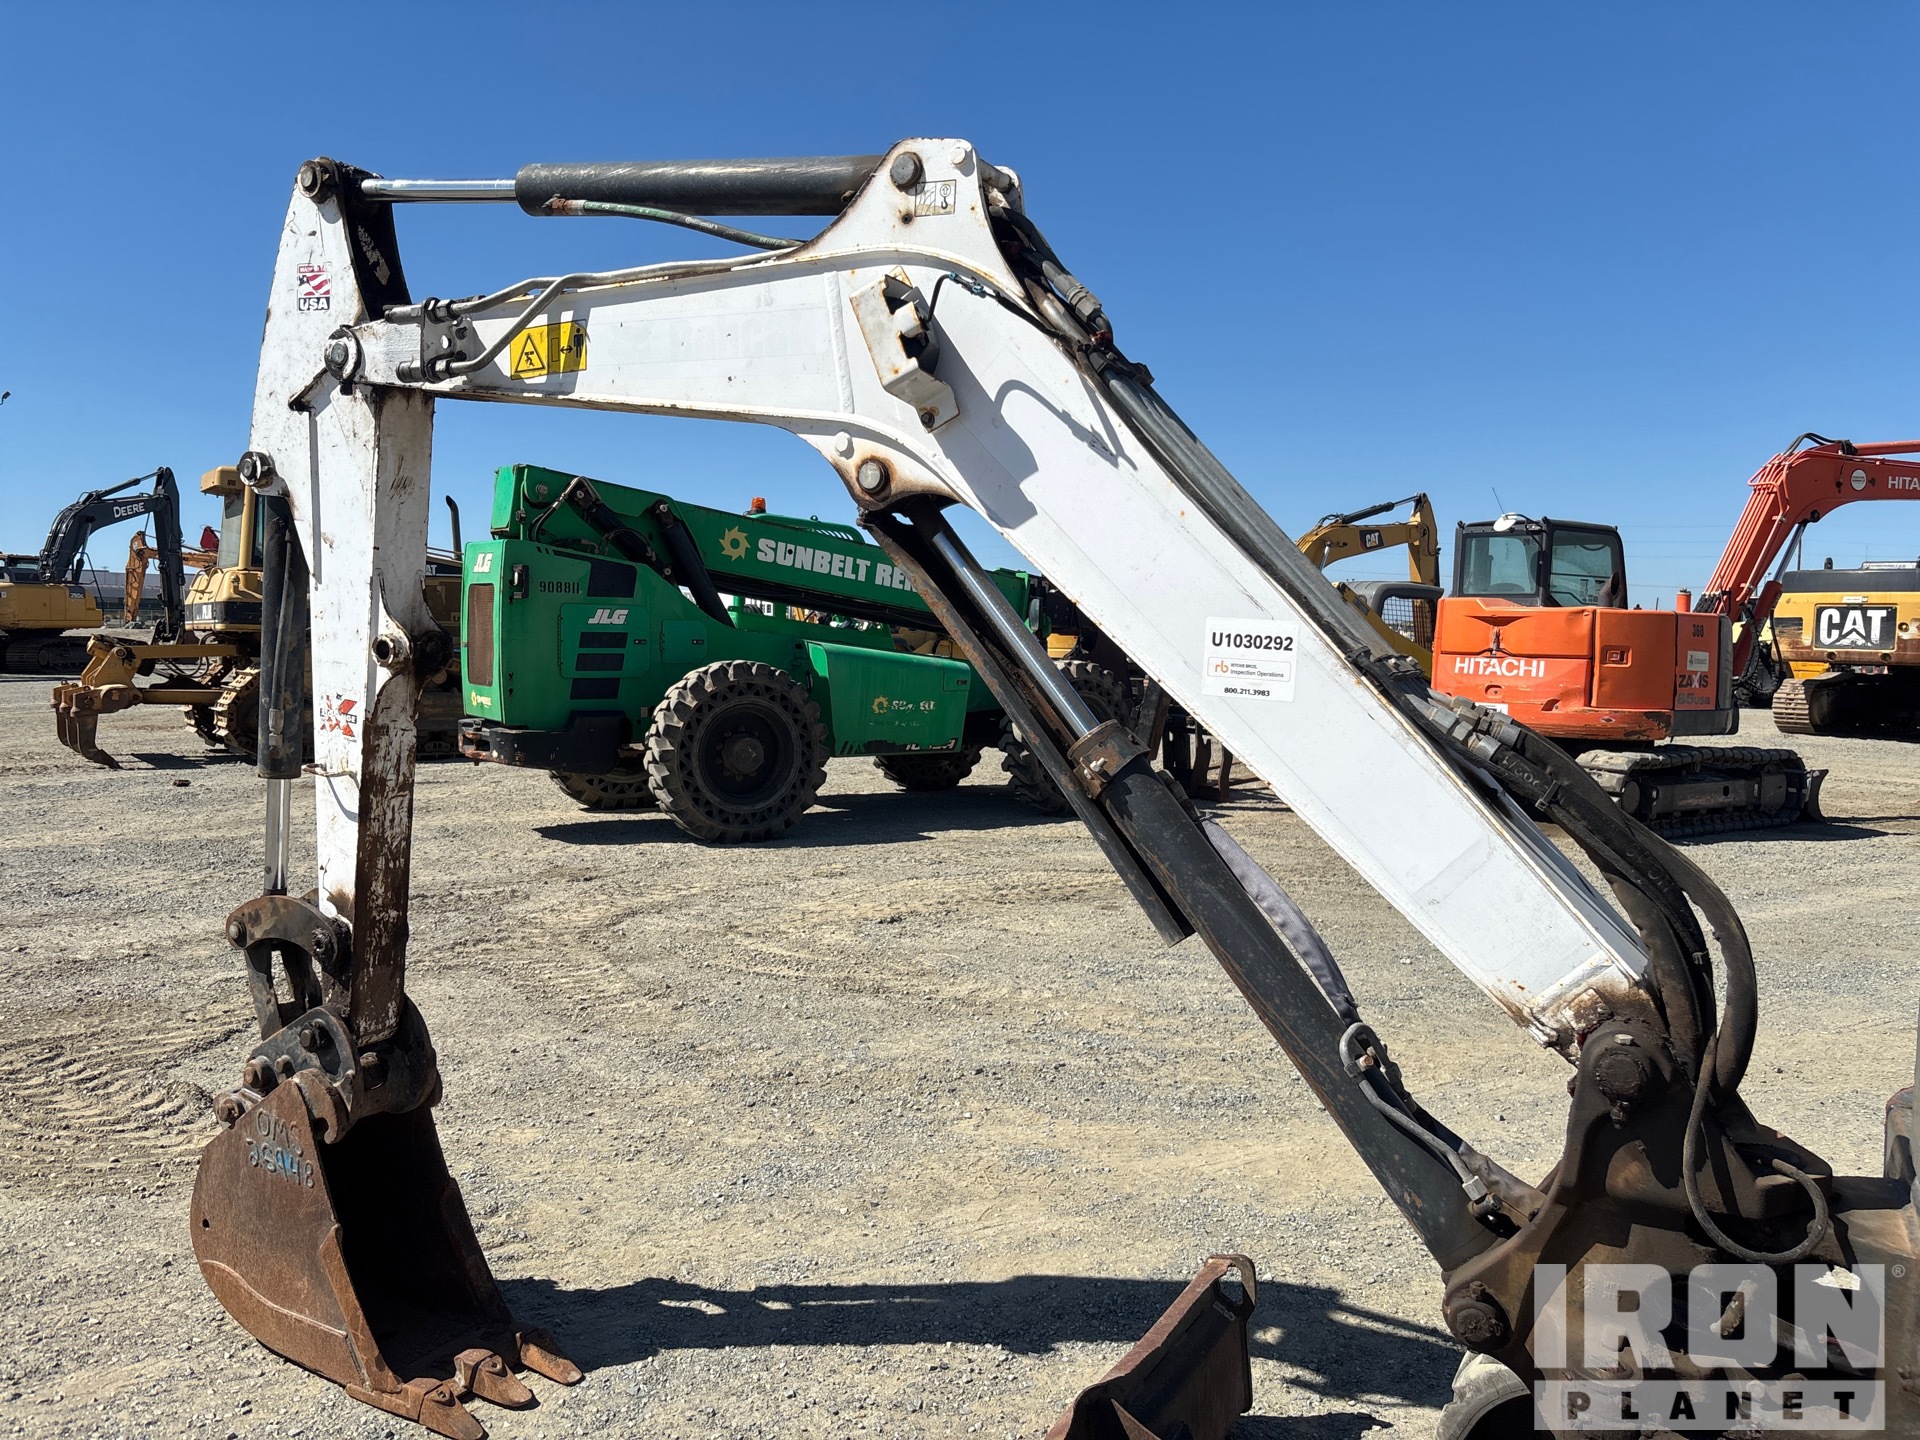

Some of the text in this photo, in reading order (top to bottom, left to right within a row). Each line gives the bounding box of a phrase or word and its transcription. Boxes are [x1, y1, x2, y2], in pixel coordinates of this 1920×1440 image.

[300, 298, 328, 310] USA
[113, 502, 145, 518] DEERE
[1366, 532, 1379, 547] CAT
[473, 553, 493, 573] JLG
[757, 538, 871, 582] SUNBELT
[539, 581, 580, 594] 908811
[588, 608, 629, 624] JLG
[1692, 624, 1704, 638] 360
[1819, 608, 1887, 646] CAT
[1212, 632, 1293, 651] U1030292
[1214, 660, 1228, 673] rb
[1454, 657, 1545, 677] HITACHI
[1678, 673, 1708, 688] ZAXIS
[1224, 687, 1270, 696] 800.211.3983
